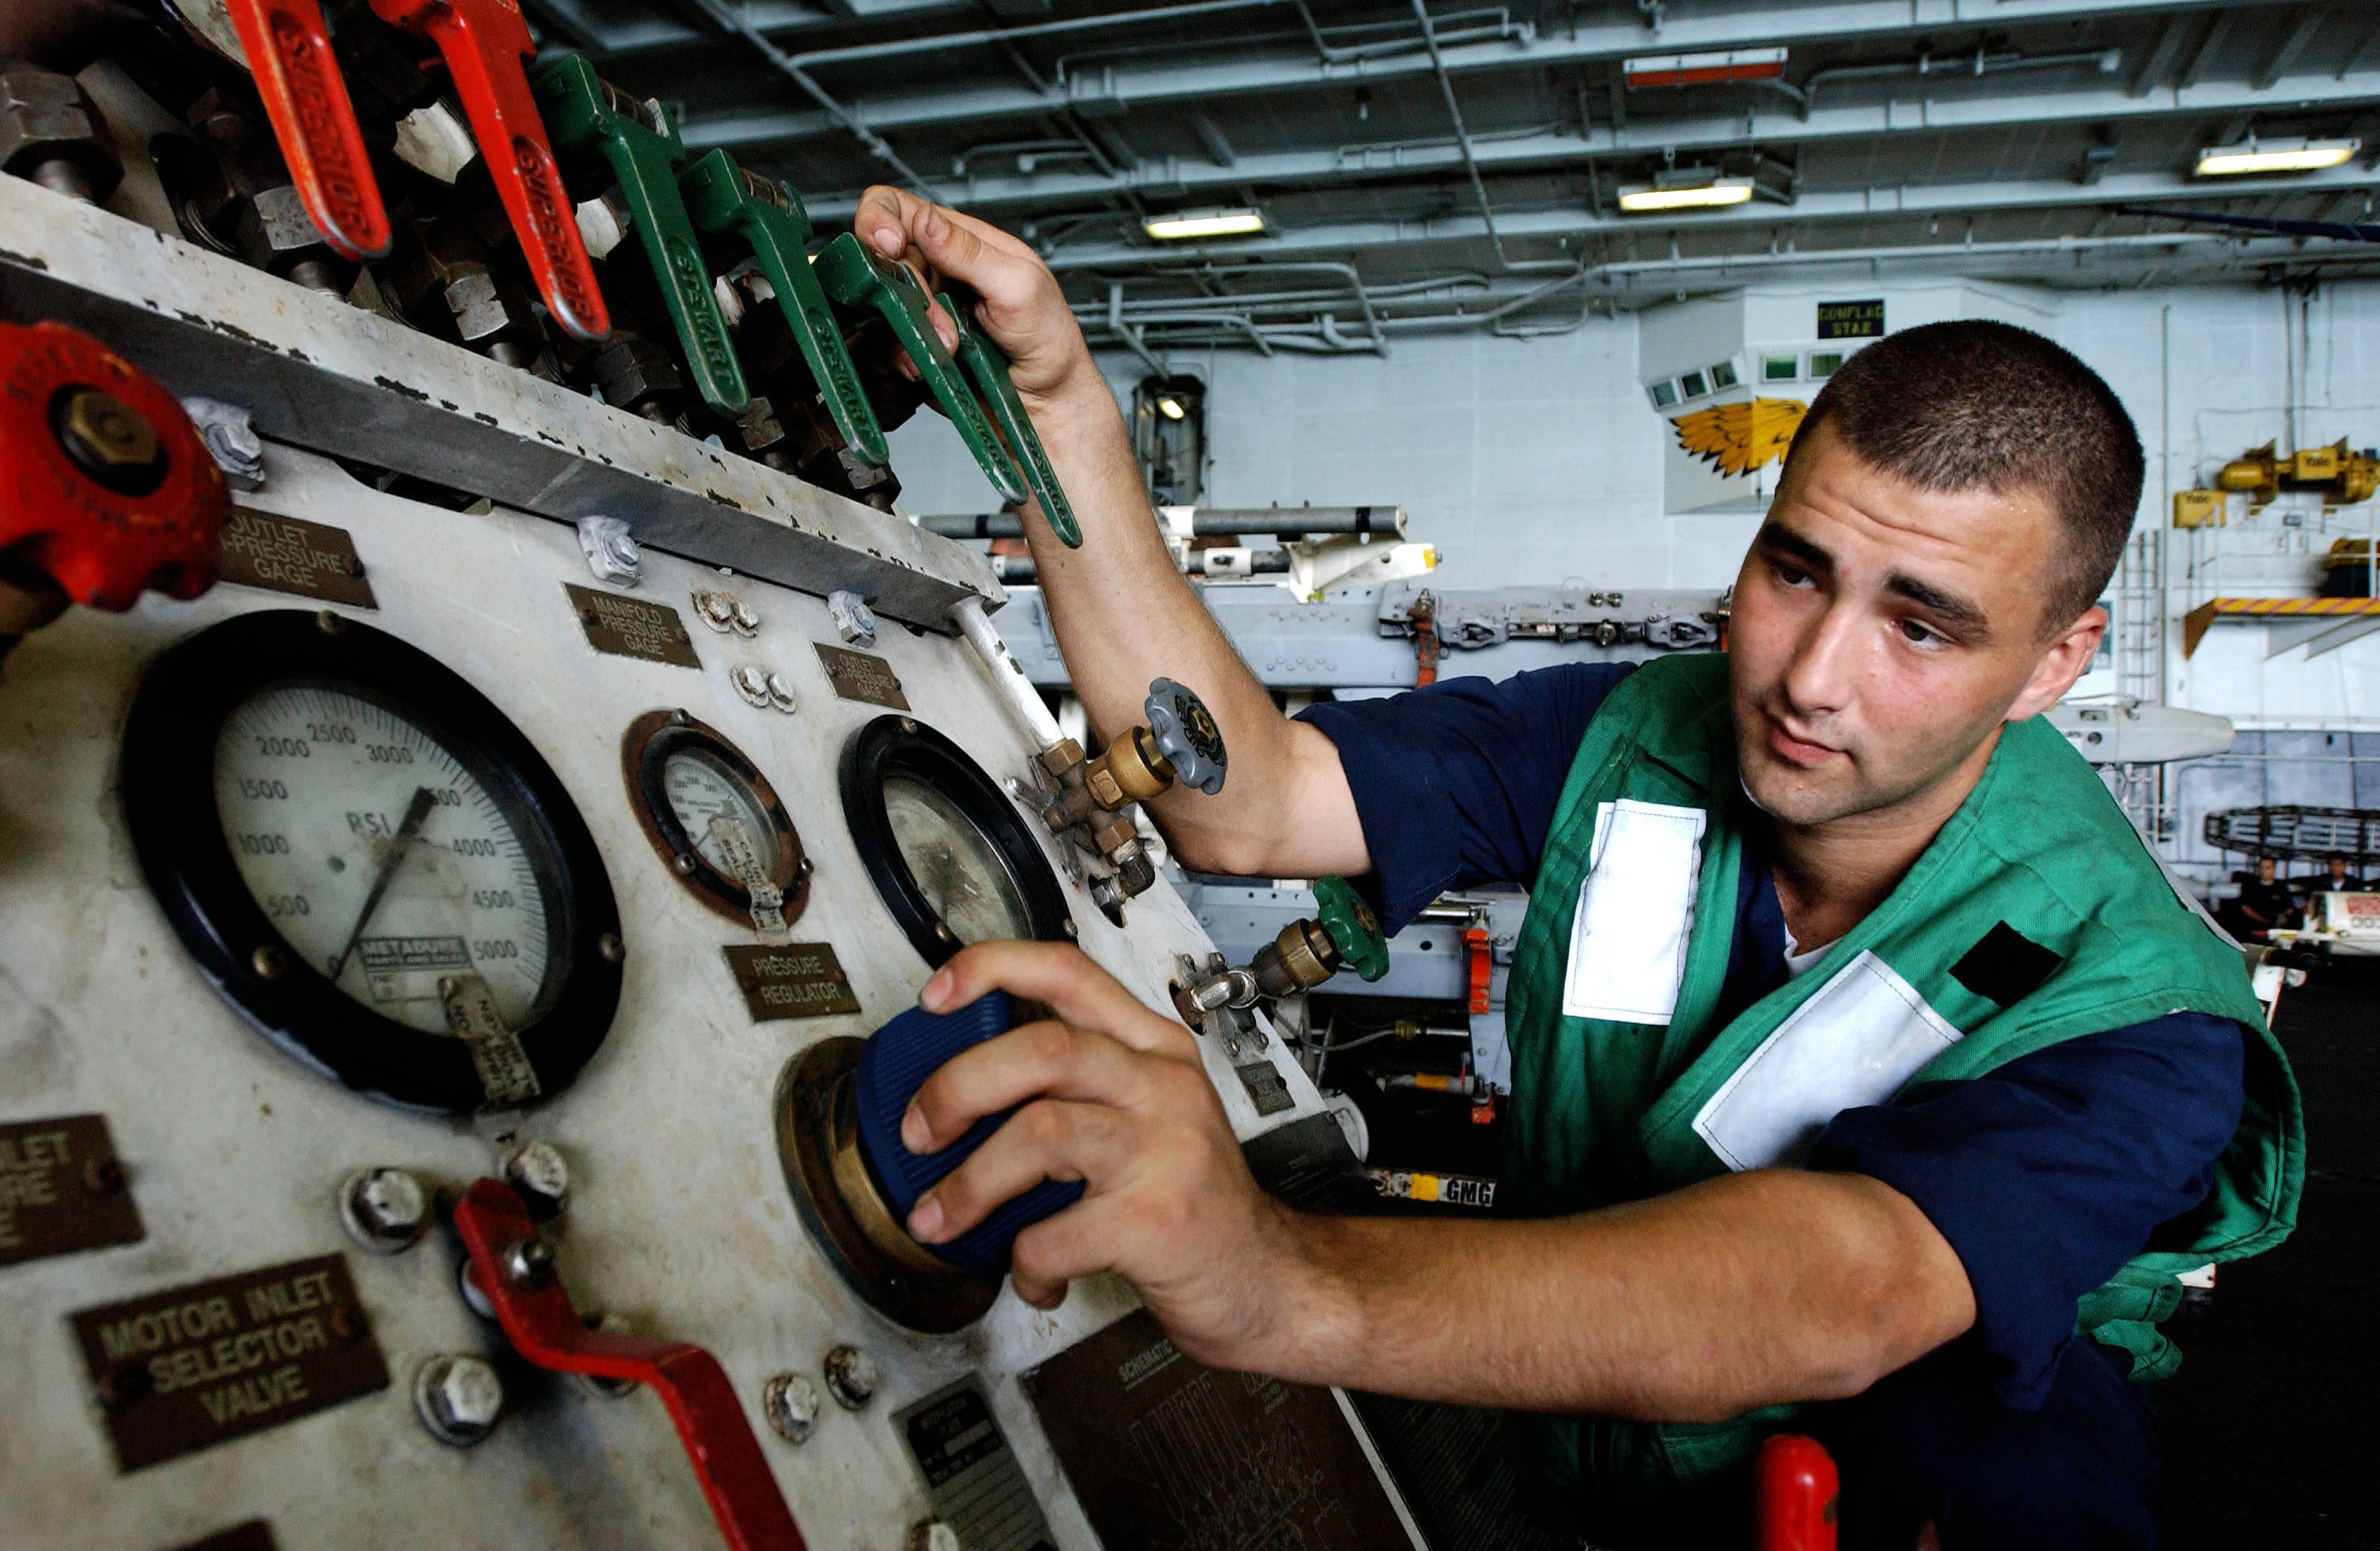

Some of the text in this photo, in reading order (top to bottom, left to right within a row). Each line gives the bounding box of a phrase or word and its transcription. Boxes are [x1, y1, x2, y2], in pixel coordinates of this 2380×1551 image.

[516, 153, 594, 319] SUPERIOR
[676, 256, 736, 386] STEWART
[253, 556, 318, 589] GAGE
[593, 597, 661, 624] MANIFOLD
[600, 614, 673, 643] PRESSURE
[624, 634, 665, 655] GAGE
[839, 654, 874, 673] OUTLET
[857, 682, 885, 700] GAGE
[306, 722, 356, 744] 2500
[256, 736, 309, 758] 2000
[365, 745, 414, 764] 3000
[239, 779, 288, 800] 1500
[346, 812, 391, 835] PSI
[239, 834, 290, 855] 1000
[453, 839, 496, 856] 4000
[722, 839, 742, 873] SEAL
[268, 894, 310, 916] 500
[473, 889, 514, 908] 4500
[474, 939, 517, 959] 5000
[752, 955, 824, 977] PRESSURE
[760, 981, 842, 1005] REGULATOR
[0, 1130, 70, 1173] LET
[1446, 1177, 1492, 1205] GMG
[100, 1271, 335, 1359] MOTOR INLET
[148, 1315, 330, 1394] SELECTOR
[199, 1363, 310, 1424] VALVE
